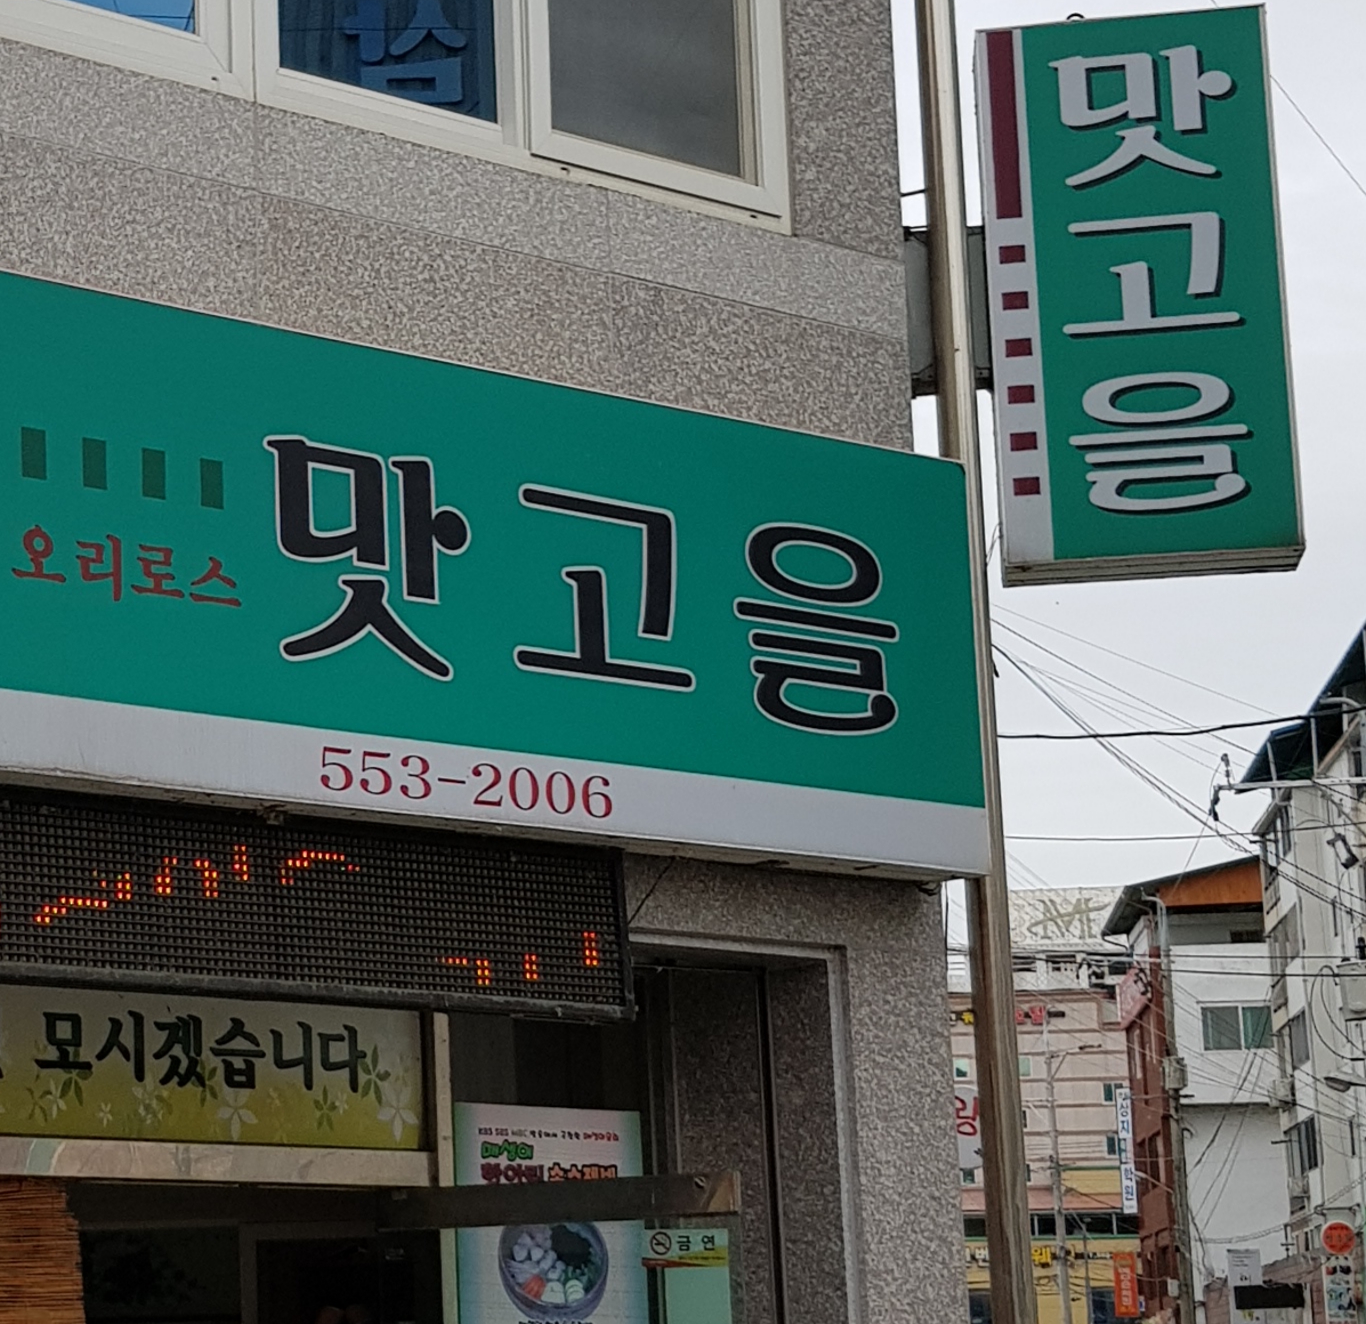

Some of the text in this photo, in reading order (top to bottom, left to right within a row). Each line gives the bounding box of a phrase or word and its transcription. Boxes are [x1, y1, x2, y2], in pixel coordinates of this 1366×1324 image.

[1047, 44, 1255, 514] 맛고을
[11, 524, 242, 608] 오리로스
[262, 434, 901, 736] 맛고을
[319, 745, 615, 820] 553-2006
[33, 1009, 368, 1094] 모시겠습니다
